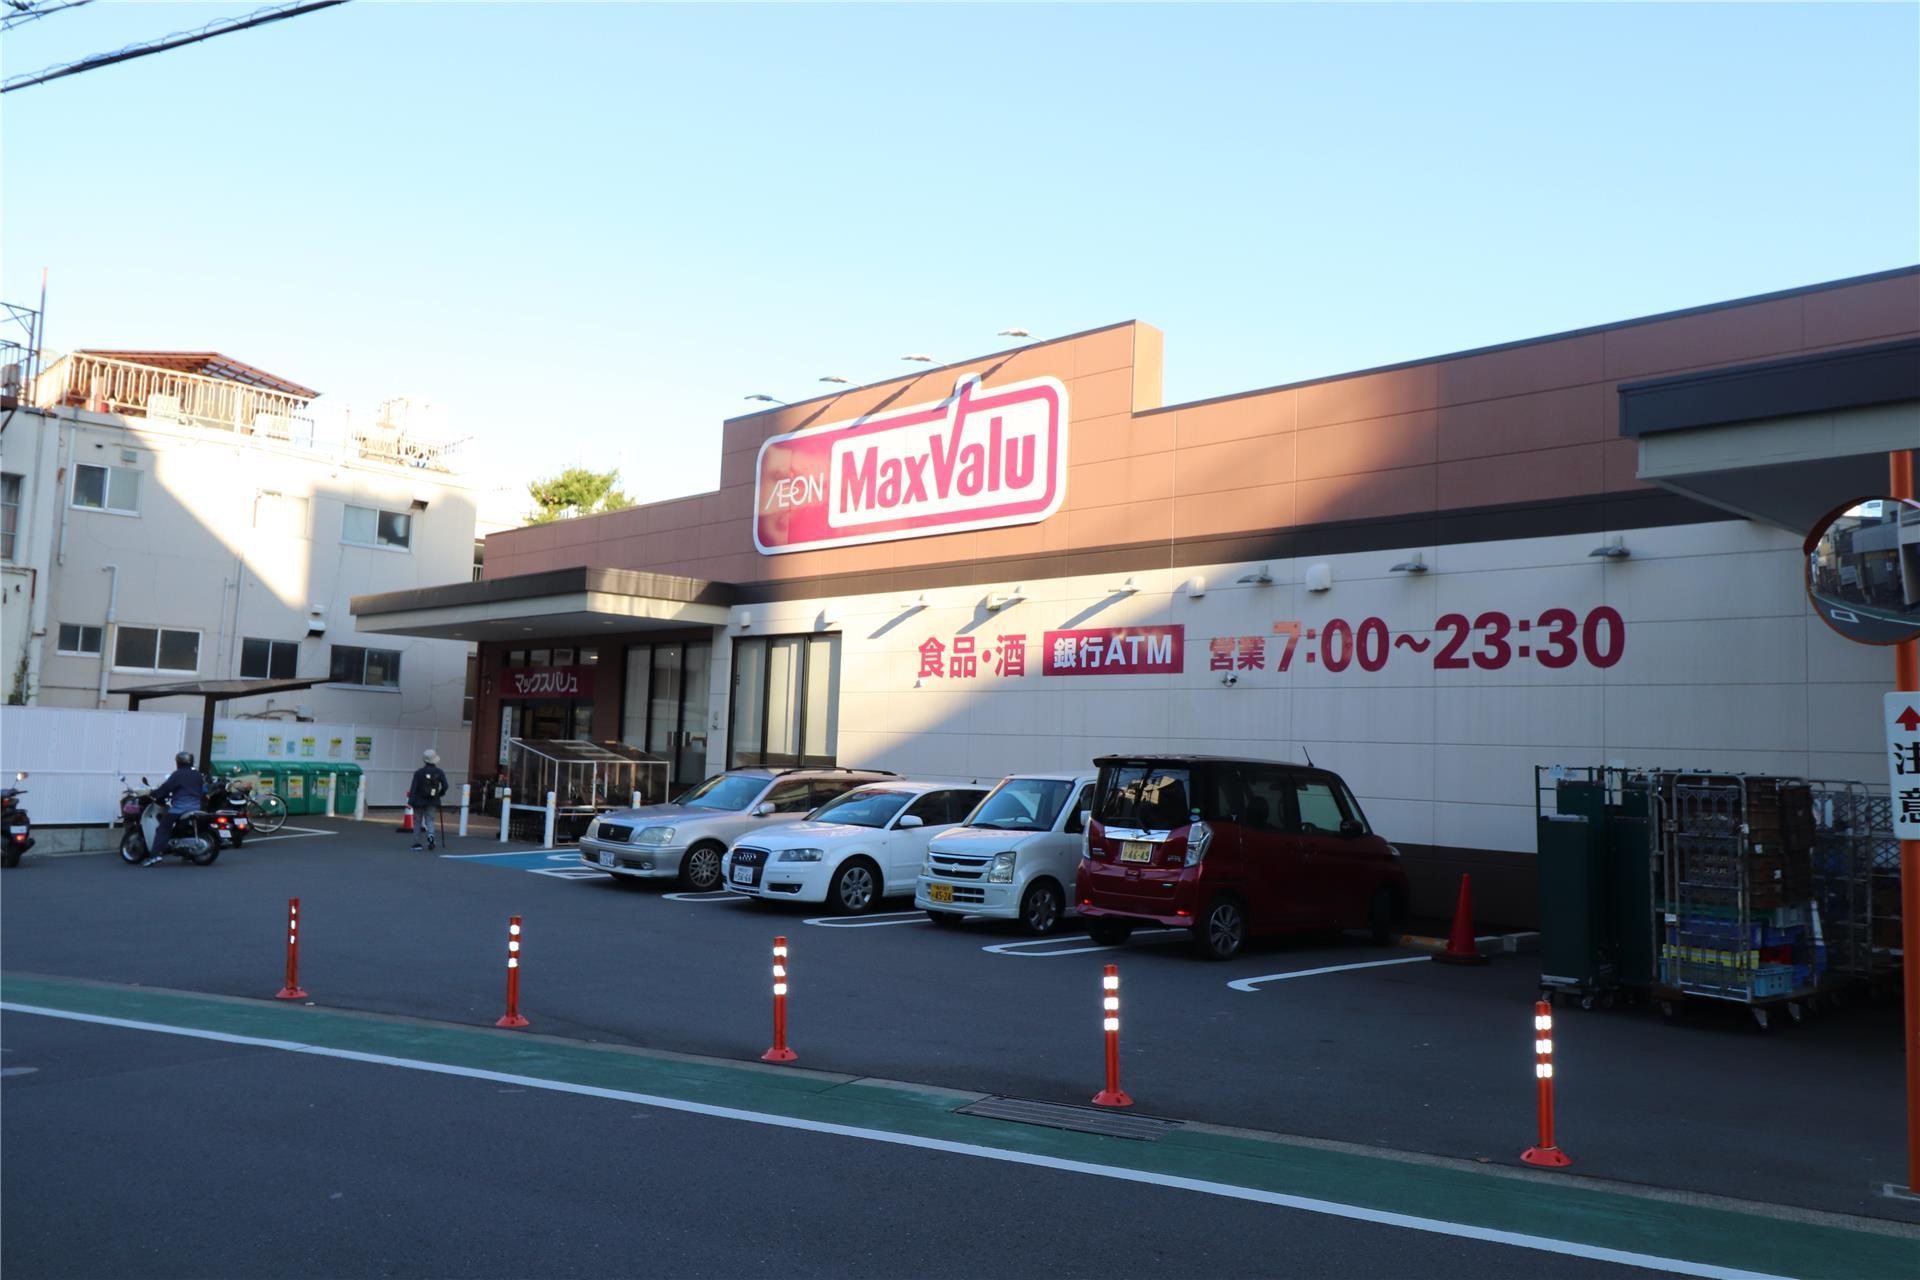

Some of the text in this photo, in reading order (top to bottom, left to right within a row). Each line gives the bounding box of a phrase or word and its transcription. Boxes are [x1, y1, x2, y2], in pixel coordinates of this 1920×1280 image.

[839, 383, 1035, 514] MaxValu
[1053, 634, 1172, 670] 銀行ATM
[1210, 636, 1264, 671] 営業
[515, 671, 578, 693] マックスバリュ
